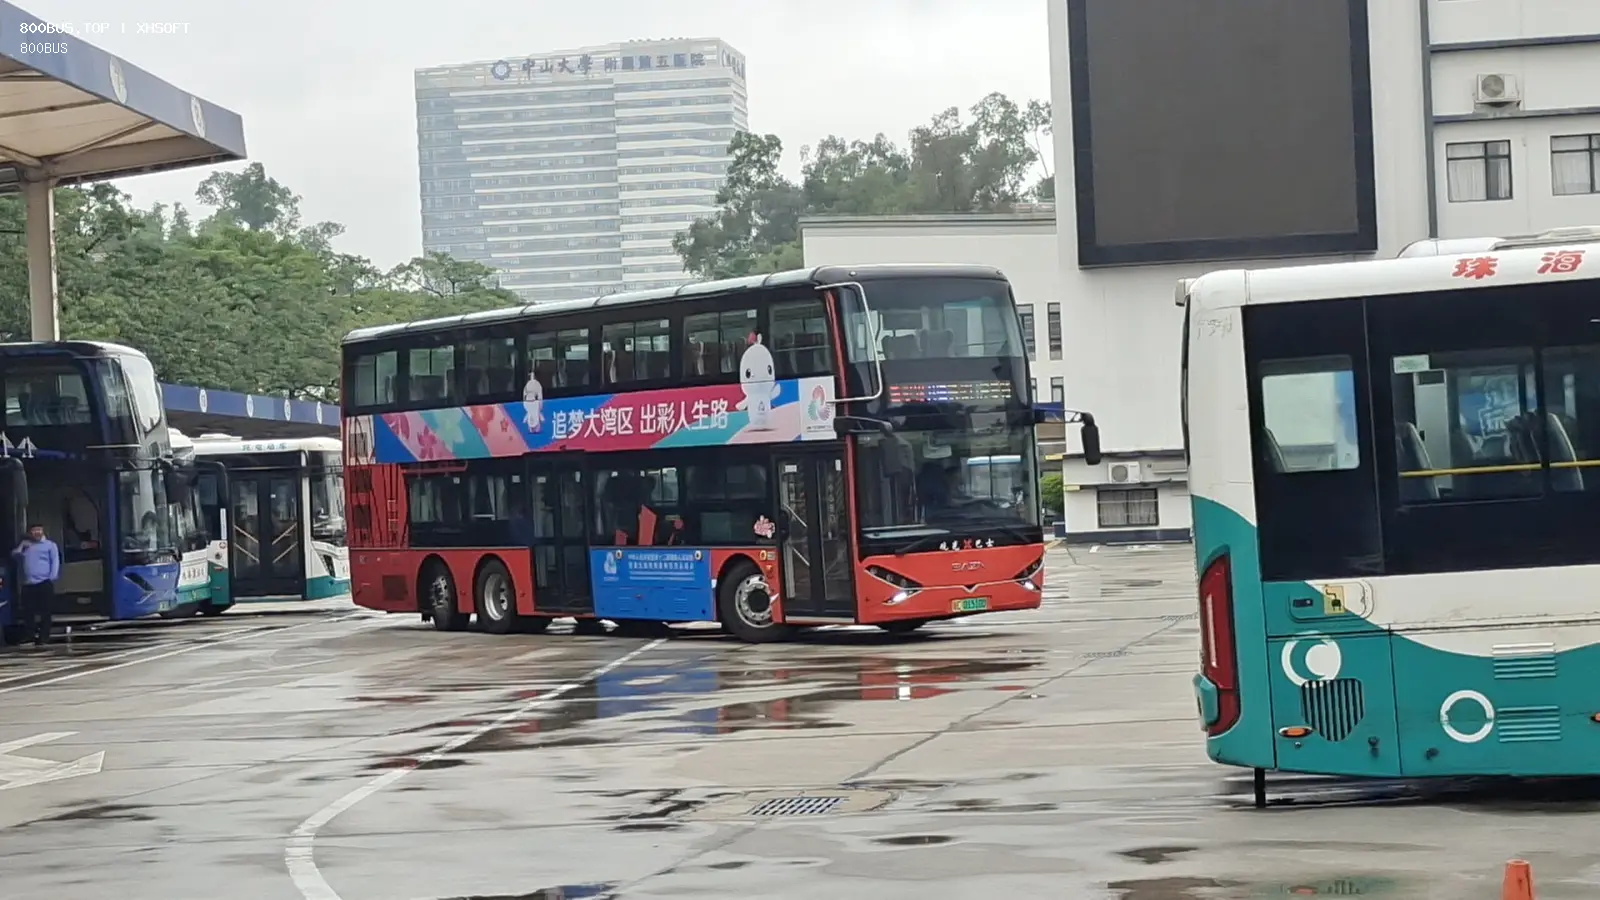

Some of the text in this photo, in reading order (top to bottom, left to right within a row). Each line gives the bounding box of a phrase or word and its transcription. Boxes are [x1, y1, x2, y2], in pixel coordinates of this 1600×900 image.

[1452, 249, 1586, 280] 珠海
[551, 398, 729, 440] 追梦大湾区 出彩人生路
